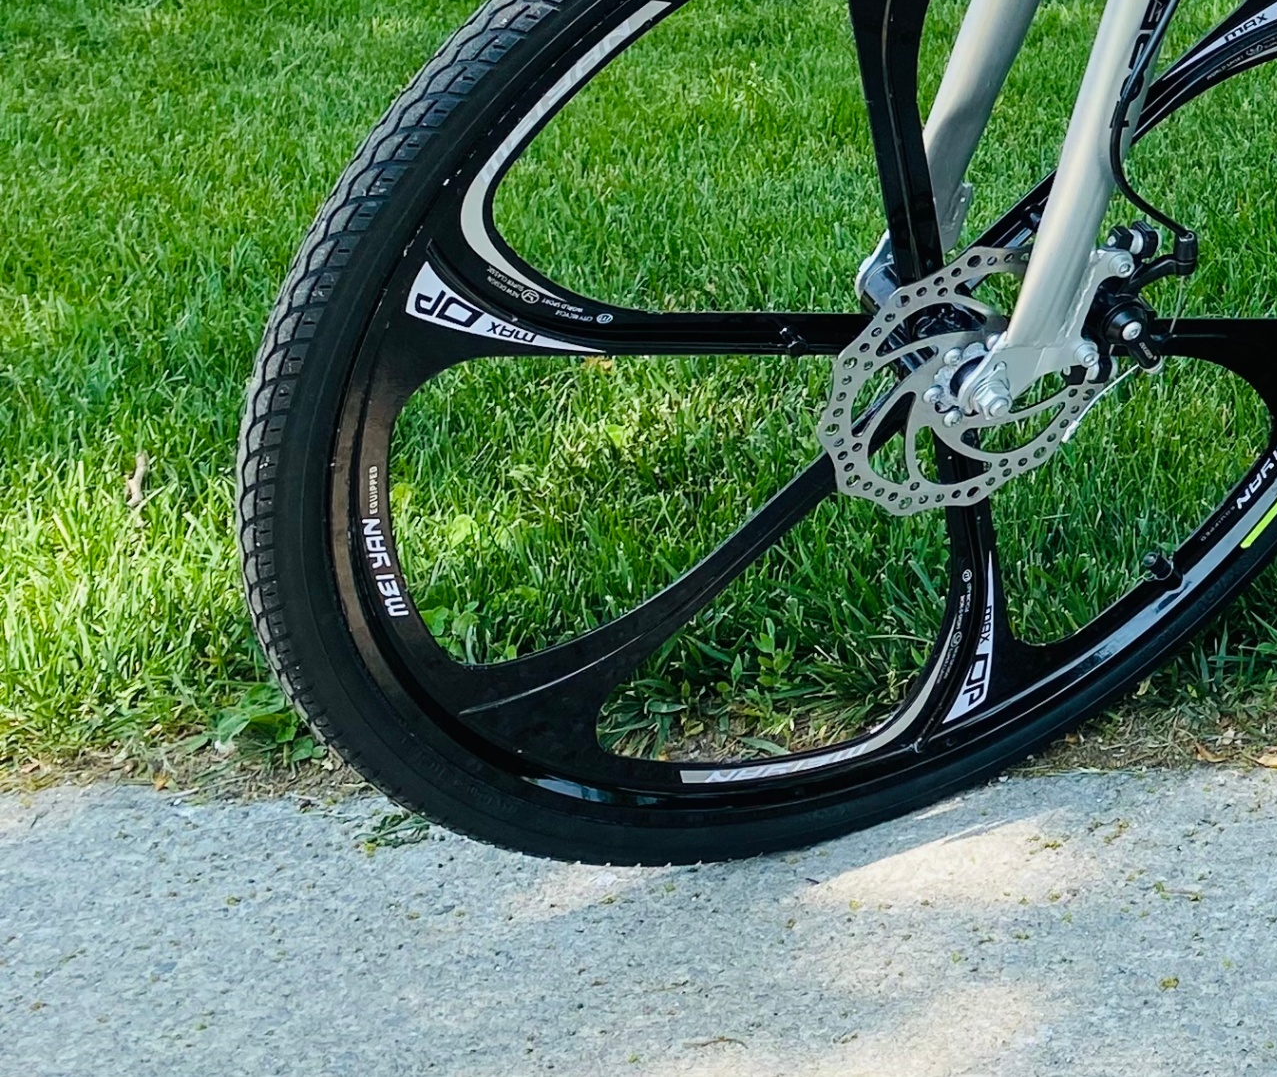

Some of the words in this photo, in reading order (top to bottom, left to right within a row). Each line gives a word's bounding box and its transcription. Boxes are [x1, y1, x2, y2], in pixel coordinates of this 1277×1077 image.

[369, 465, 378, 515] EQUIPPED
[361, 518, 391, 569] YAN
[375, 573, 409, 618] MEI
